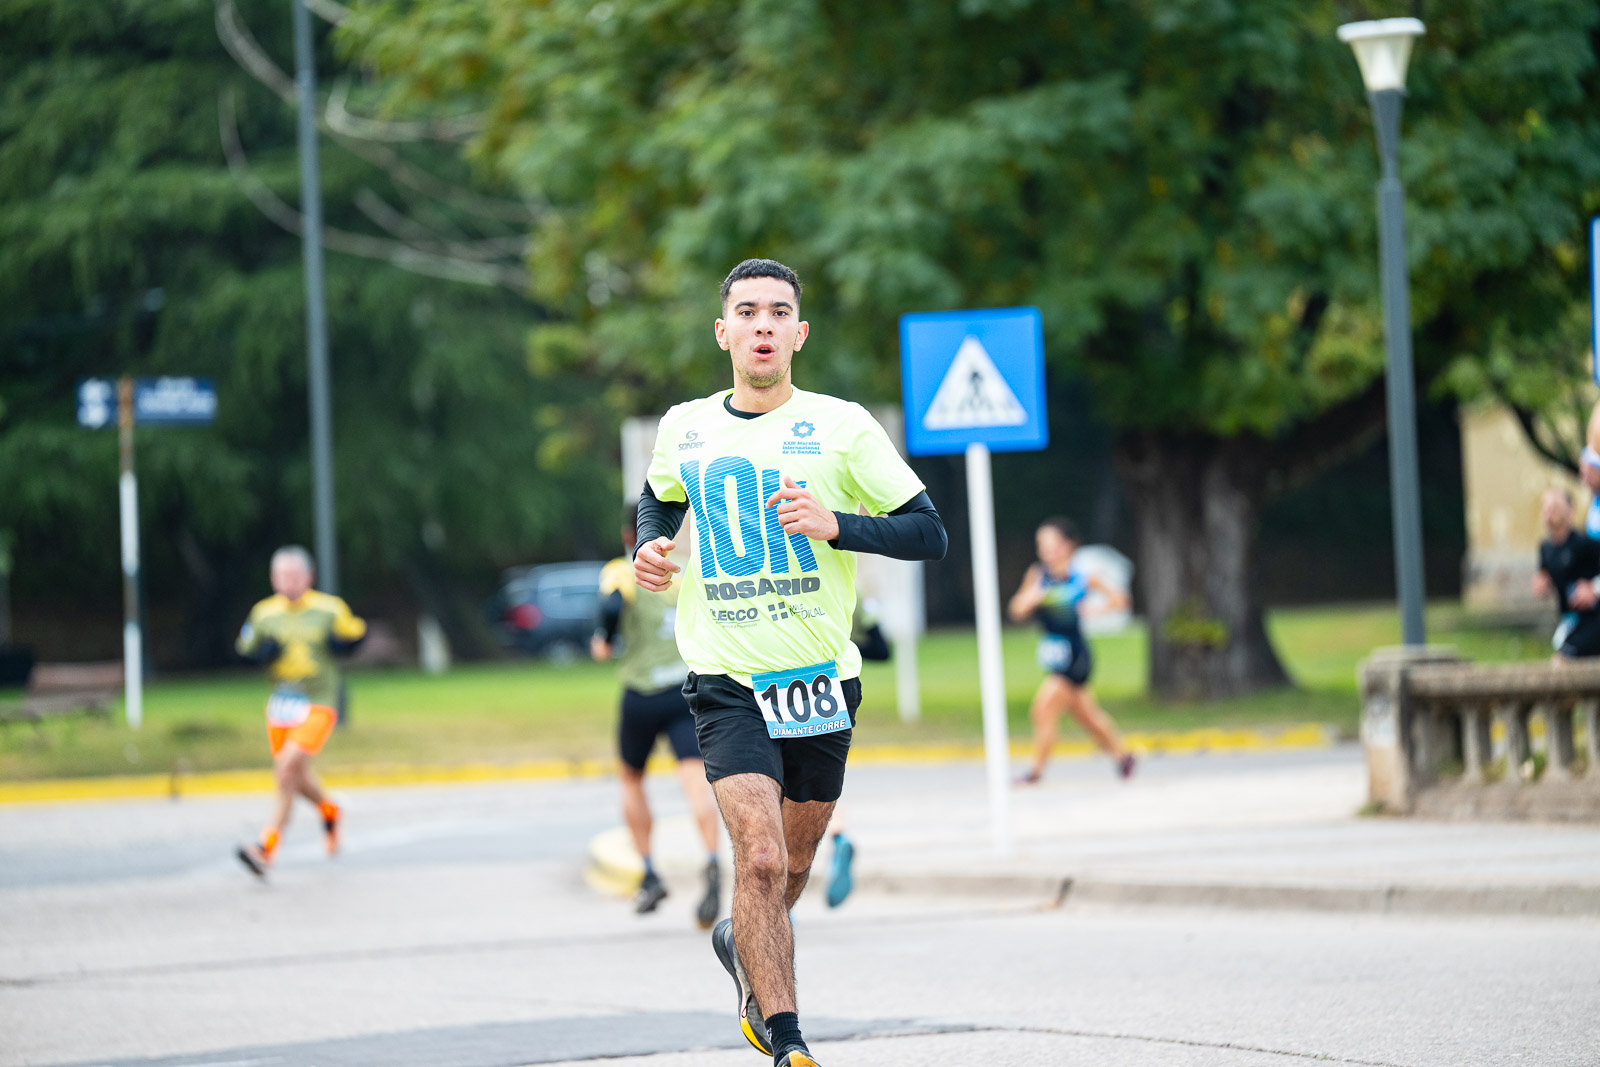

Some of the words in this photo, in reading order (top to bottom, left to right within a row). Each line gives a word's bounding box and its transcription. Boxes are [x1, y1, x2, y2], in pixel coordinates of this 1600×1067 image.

[704, 577, 820, 600] ROSARIO
[761, 674, 838, 725] 108
[773, 725, 813, 736] DIAMANTE
[815, 719, 846, 732] CORRE
